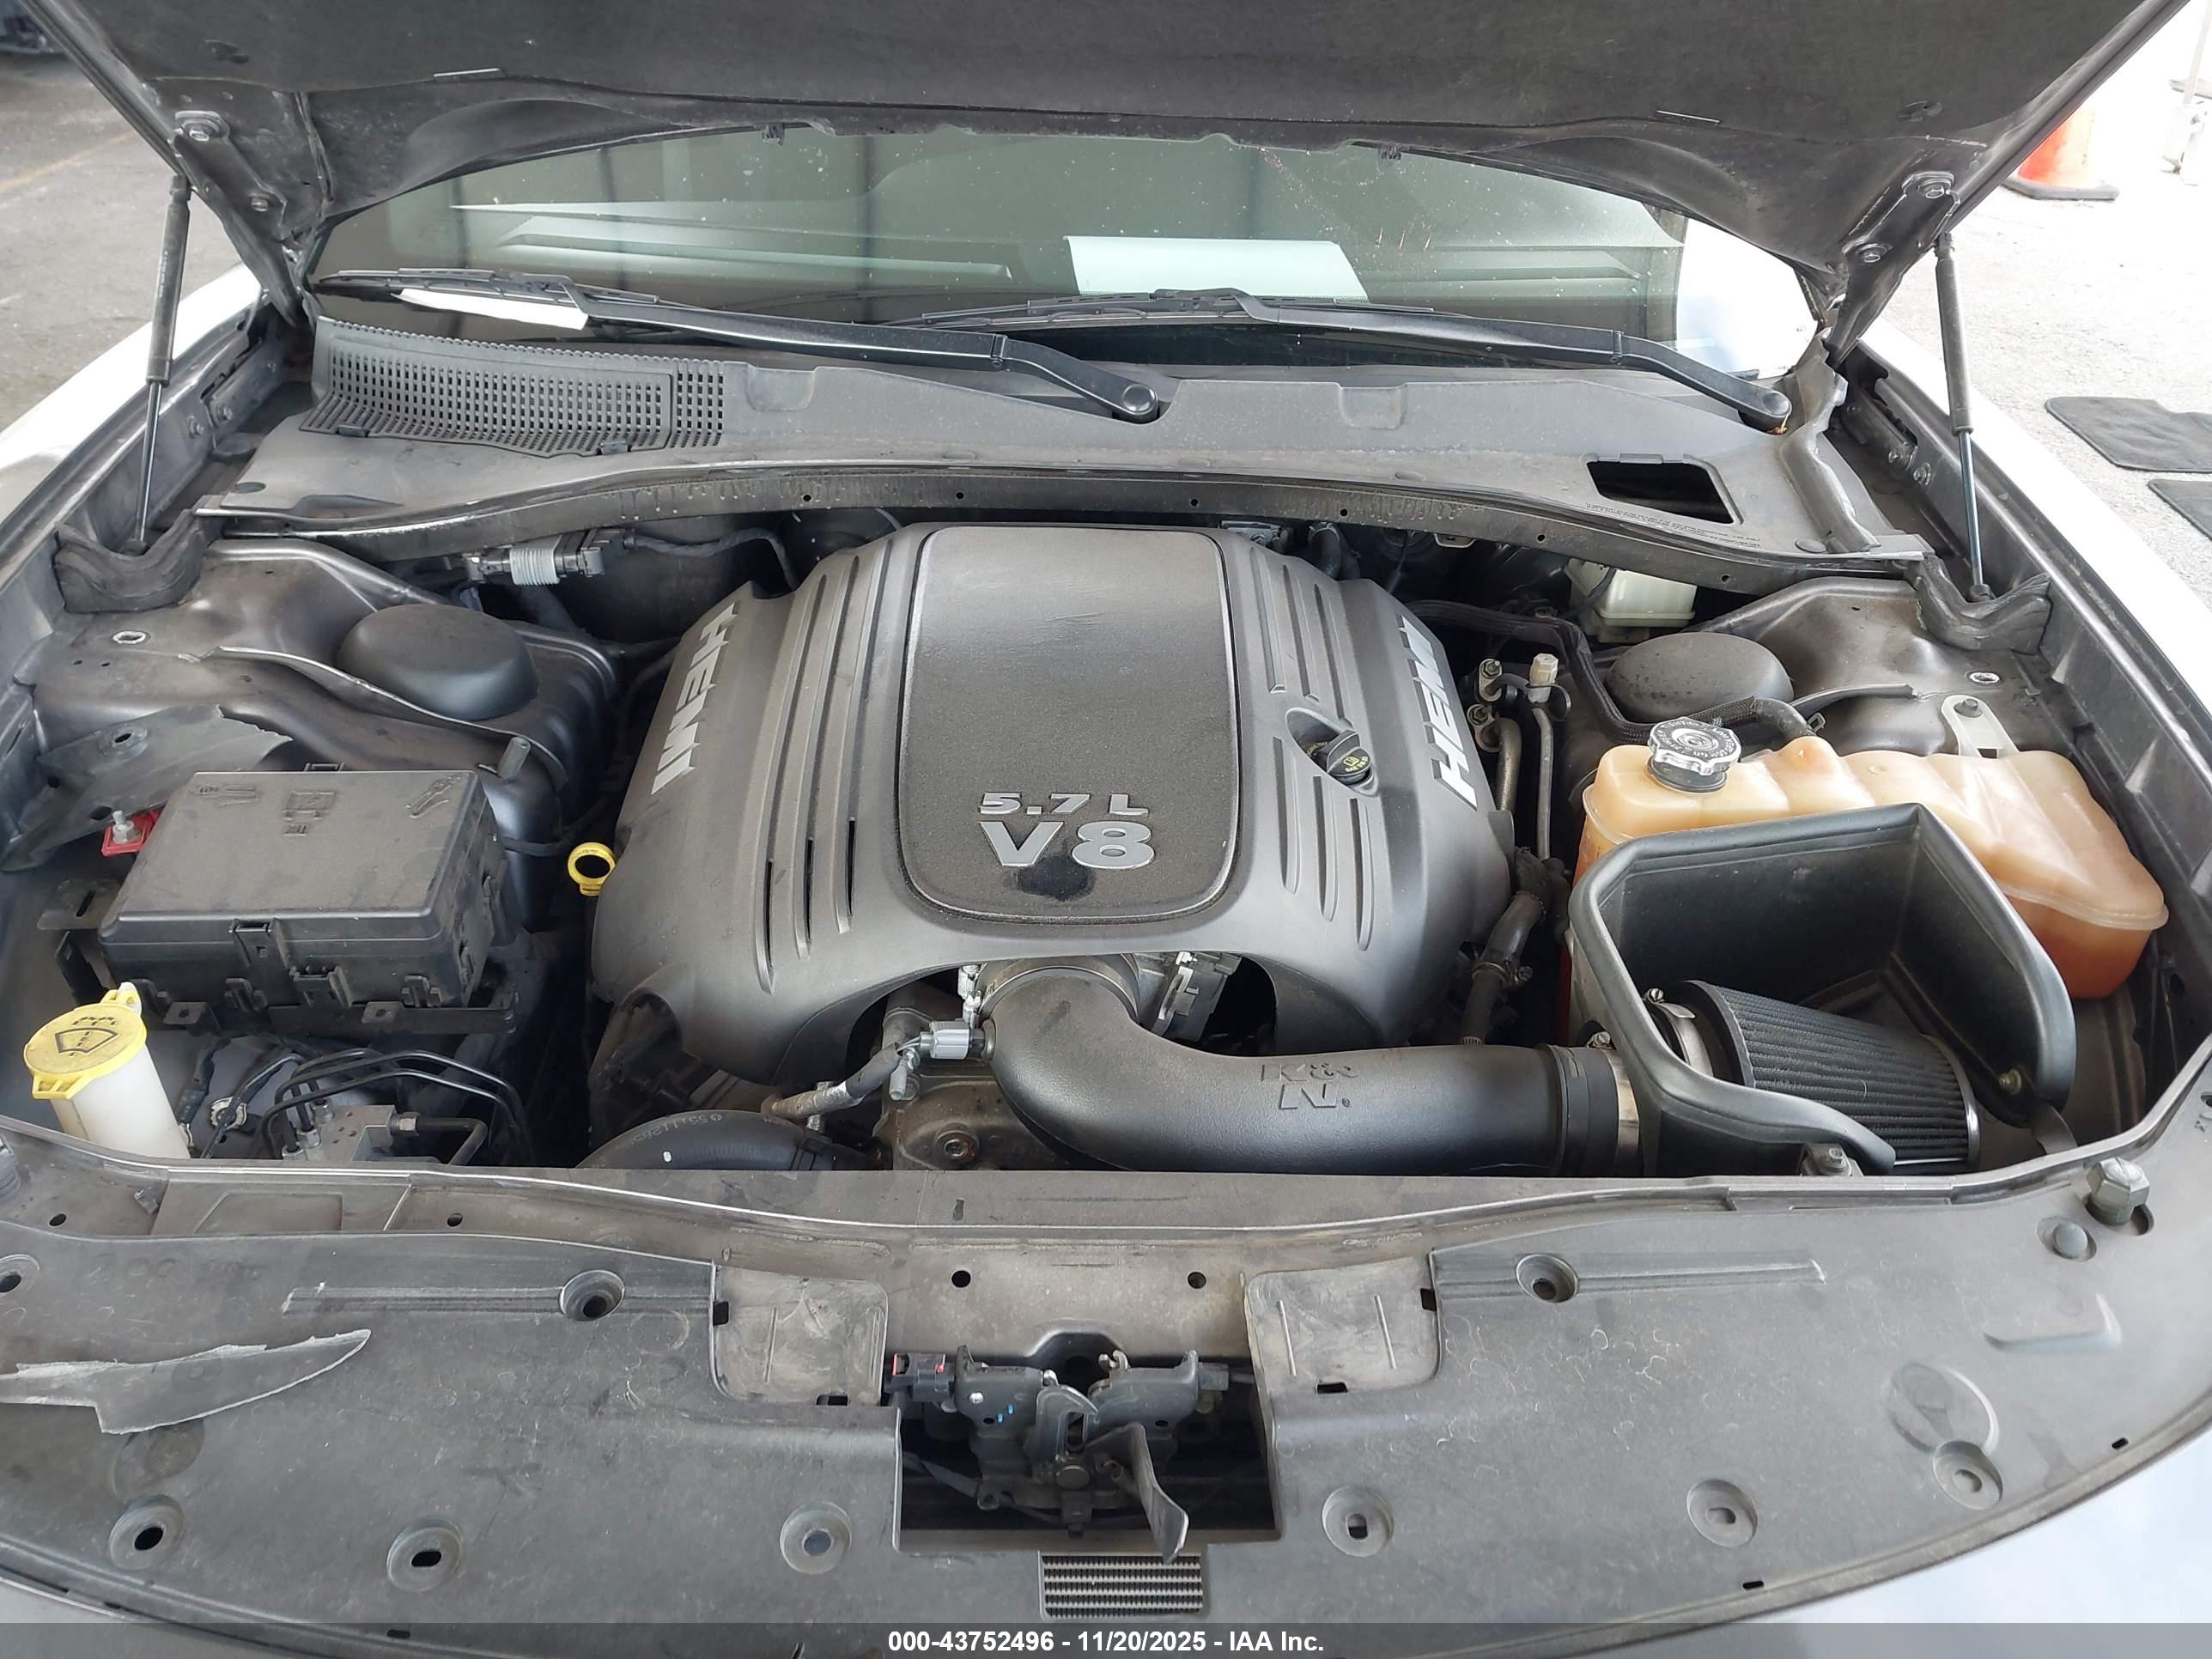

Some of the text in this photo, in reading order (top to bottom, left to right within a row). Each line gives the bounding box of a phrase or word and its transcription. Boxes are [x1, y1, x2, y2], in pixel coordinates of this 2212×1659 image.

[652, 602, 738, 795] HEMI
[1399, 614, 1478, 811] HEMI
[979, 820, 1155, 870] V8
